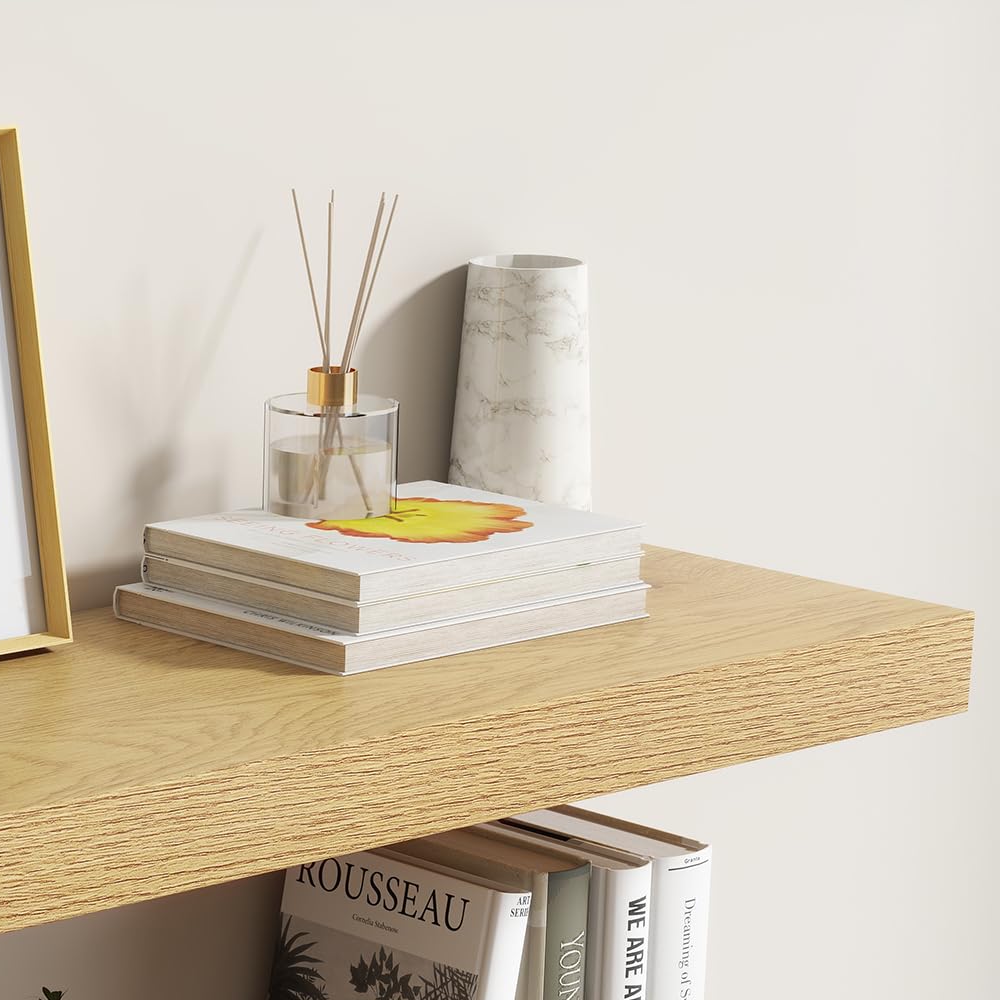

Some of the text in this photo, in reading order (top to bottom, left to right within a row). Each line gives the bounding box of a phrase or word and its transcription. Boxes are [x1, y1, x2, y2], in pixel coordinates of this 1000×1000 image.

[296, 858, 470, 931] ROUSSEAU
[352, 913, 374, 927] Cornelia
[627, 896, 647, 932] WE
[678, 898, 696, 969] Dreaming
[625, 938, 644, 978] ARE
[681, 971, 692, 986] of
